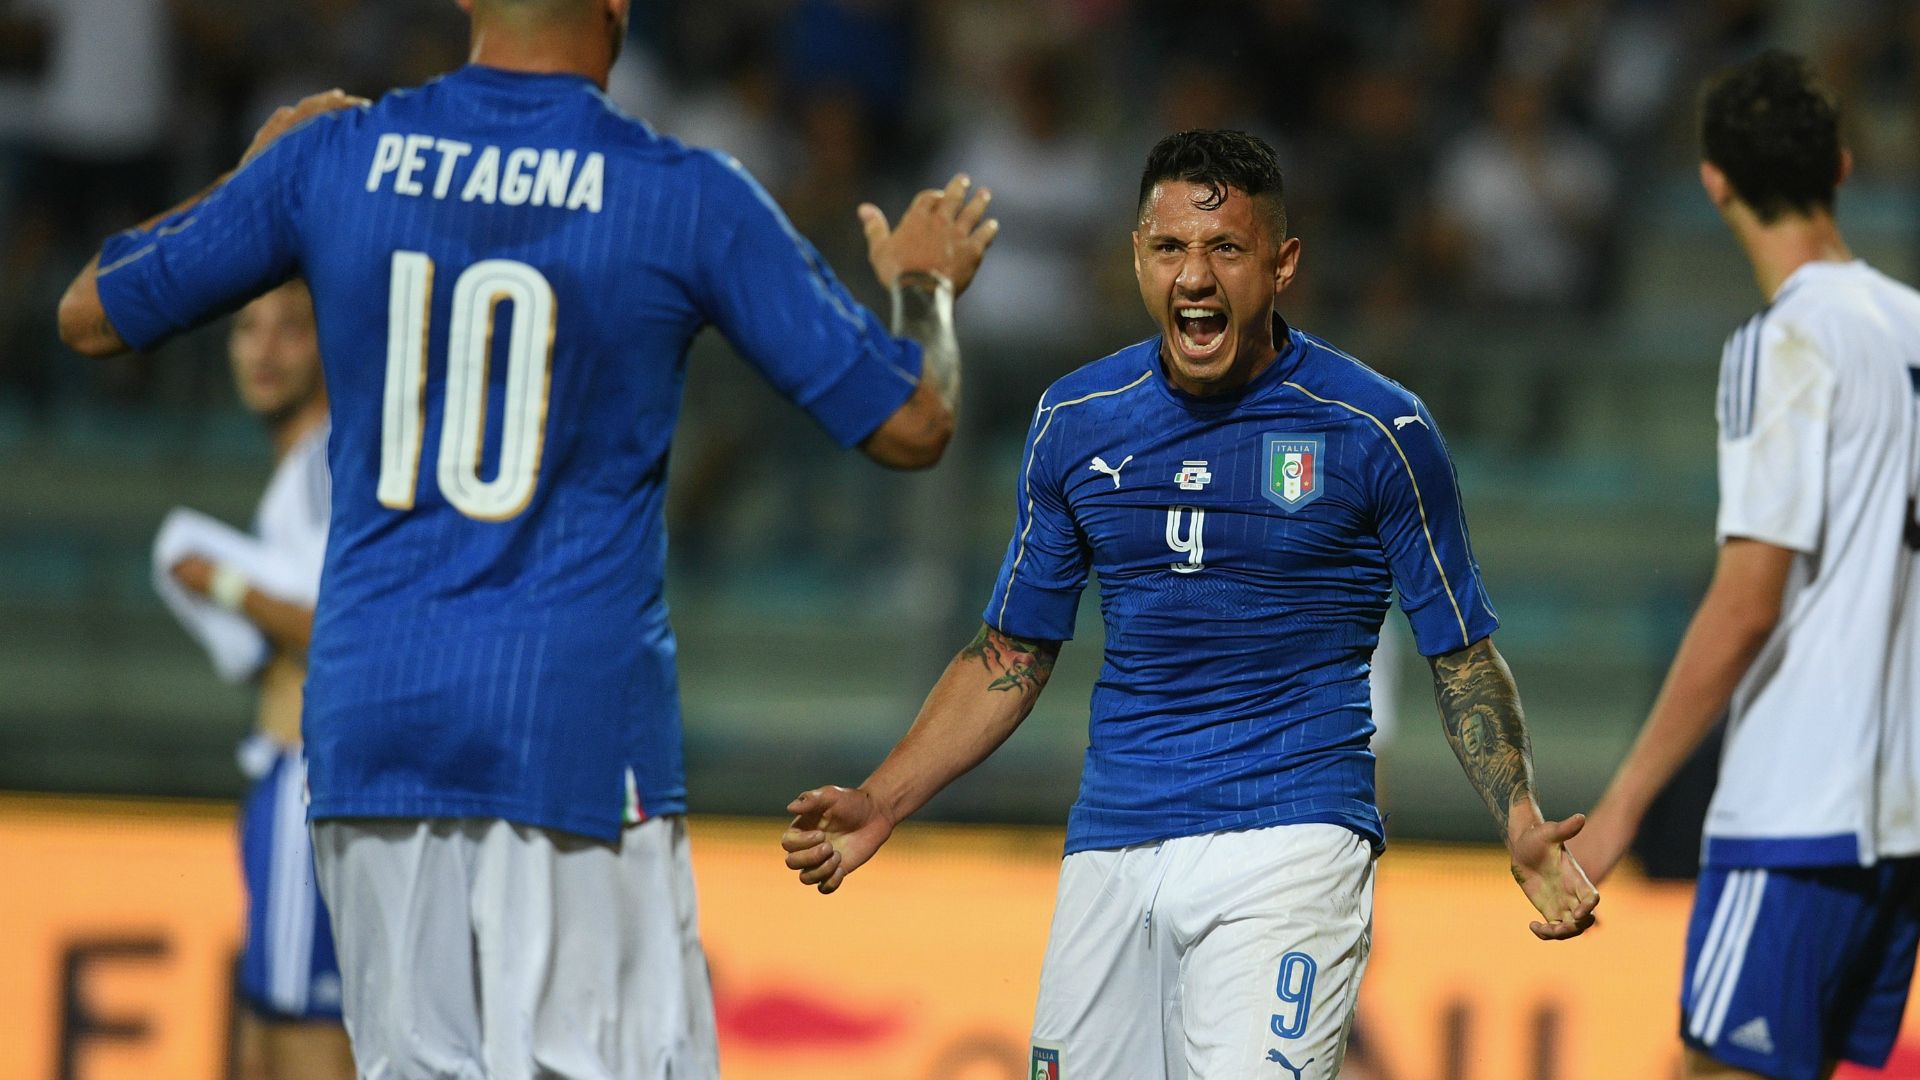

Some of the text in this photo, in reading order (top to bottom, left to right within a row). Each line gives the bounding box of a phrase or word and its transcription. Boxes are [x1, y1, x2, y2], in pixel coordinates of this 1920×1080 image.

[366, 133, 604, 213] PETAGNA
[376, 249, 557, 522] 10
[1165, 505, 1205, 573] 9
[1270, 951, 1317, 1039] 9
